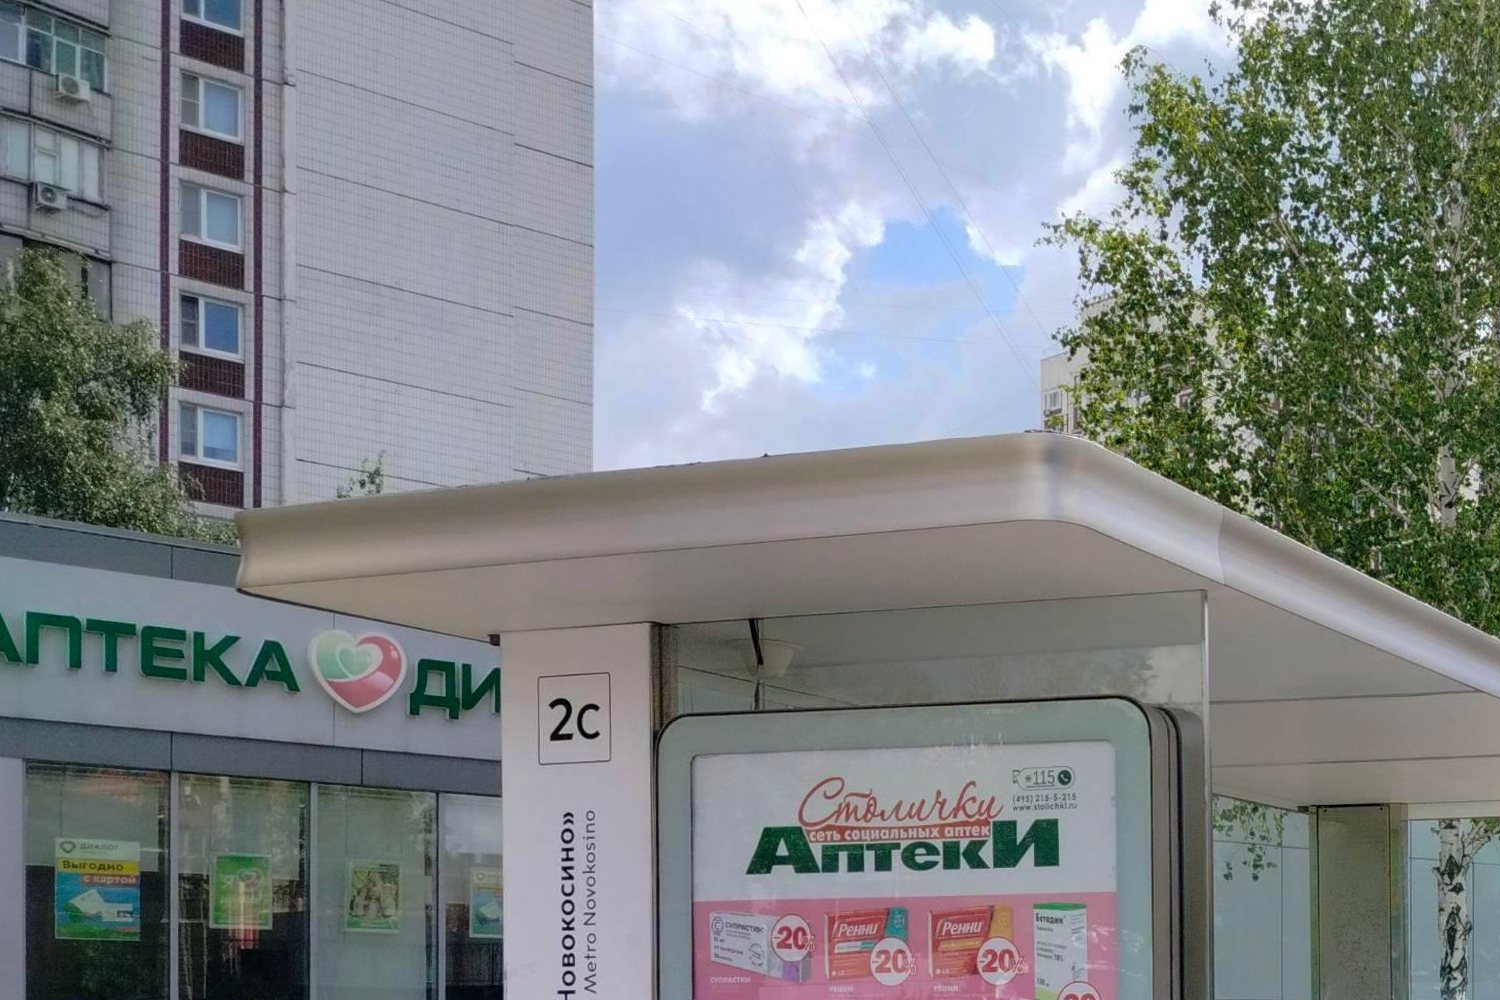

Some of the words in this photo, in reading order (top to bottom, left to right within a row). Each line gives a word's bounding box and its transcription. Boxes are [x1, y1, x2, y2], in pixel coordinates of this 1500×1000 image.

[797, 775, 1004, 828] Столички
[1012, 794, 1034, 805] (495)
[1035, 792, 1077, 803] 215-5-215
[809, 830, 841, 843] сеть
[844, 827, 940, 843] социальных
[944, 825, 990, 839] аптек
[62, 860, 124, 871] Выгодно
[582, 809, 597, 926] Novokosino
[93, 875, 136, 886] картой
[838, 922, 880, 937] Ренни
[942, 919, 983, 936] Ренни
[773, 926, 816, 953] -20%
[583, 931, 598, 994] Metro
[872, 947, 917, 976] -20%
[978, 947, 1025, 976] -20%
